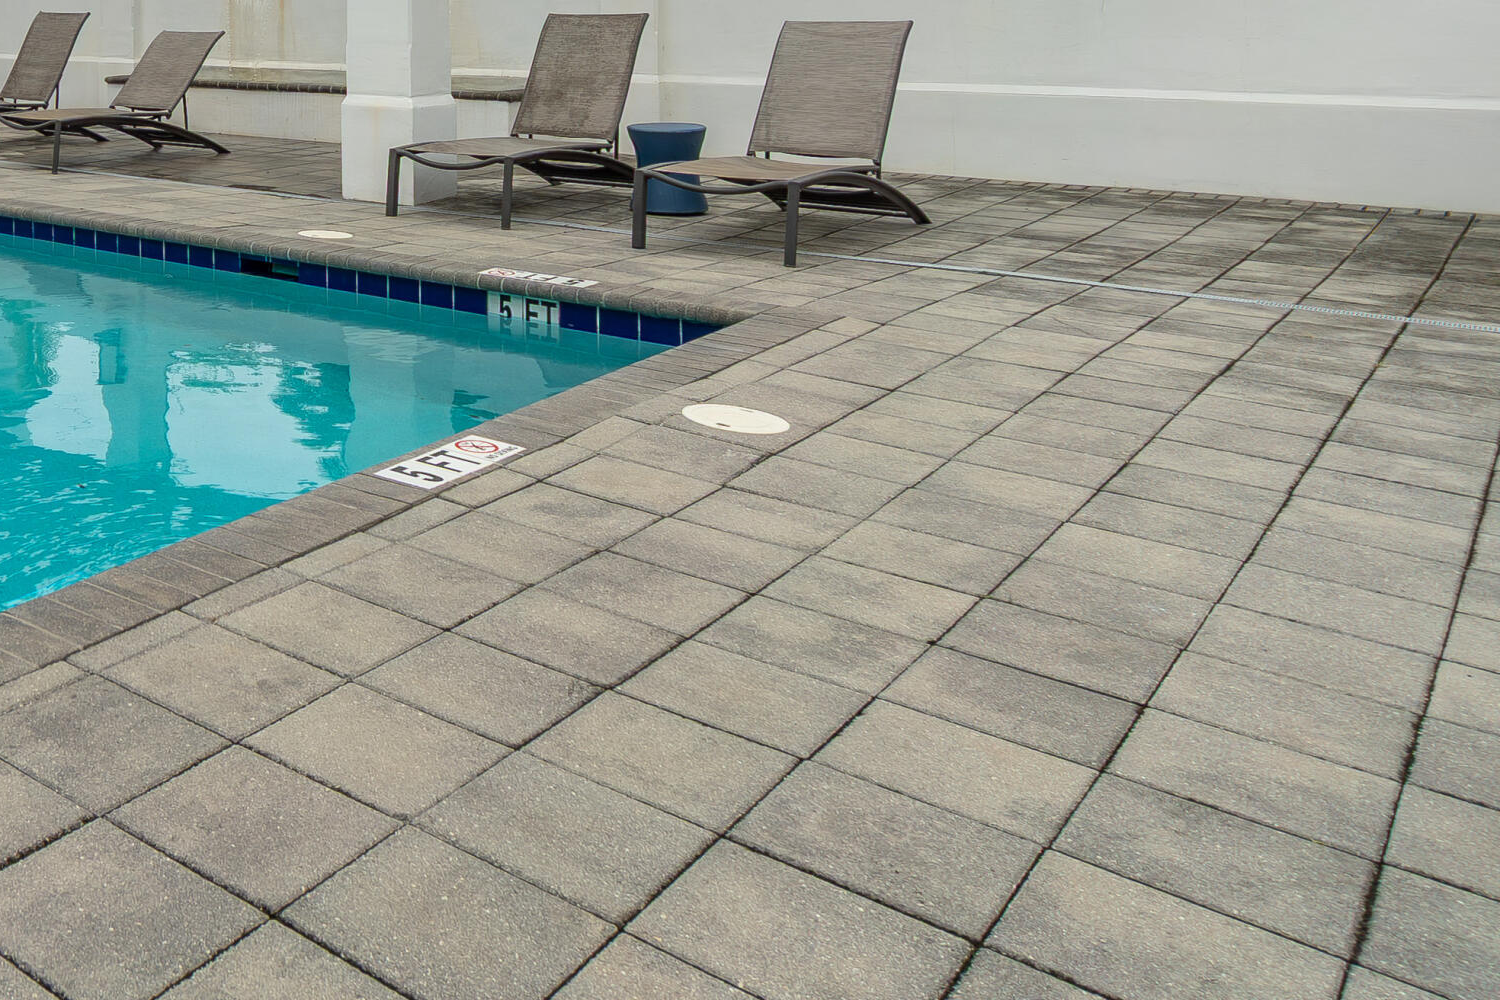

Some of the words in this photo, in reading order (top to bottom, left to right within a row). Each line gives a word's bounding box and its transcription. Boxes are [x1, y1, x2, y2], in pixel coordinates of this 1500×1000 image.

[499, 294, 512, 319] 5
[525, 298, 557, 325] FT
[416, 450, 481, 473] FT
[390, 465, 445, 483] 5
